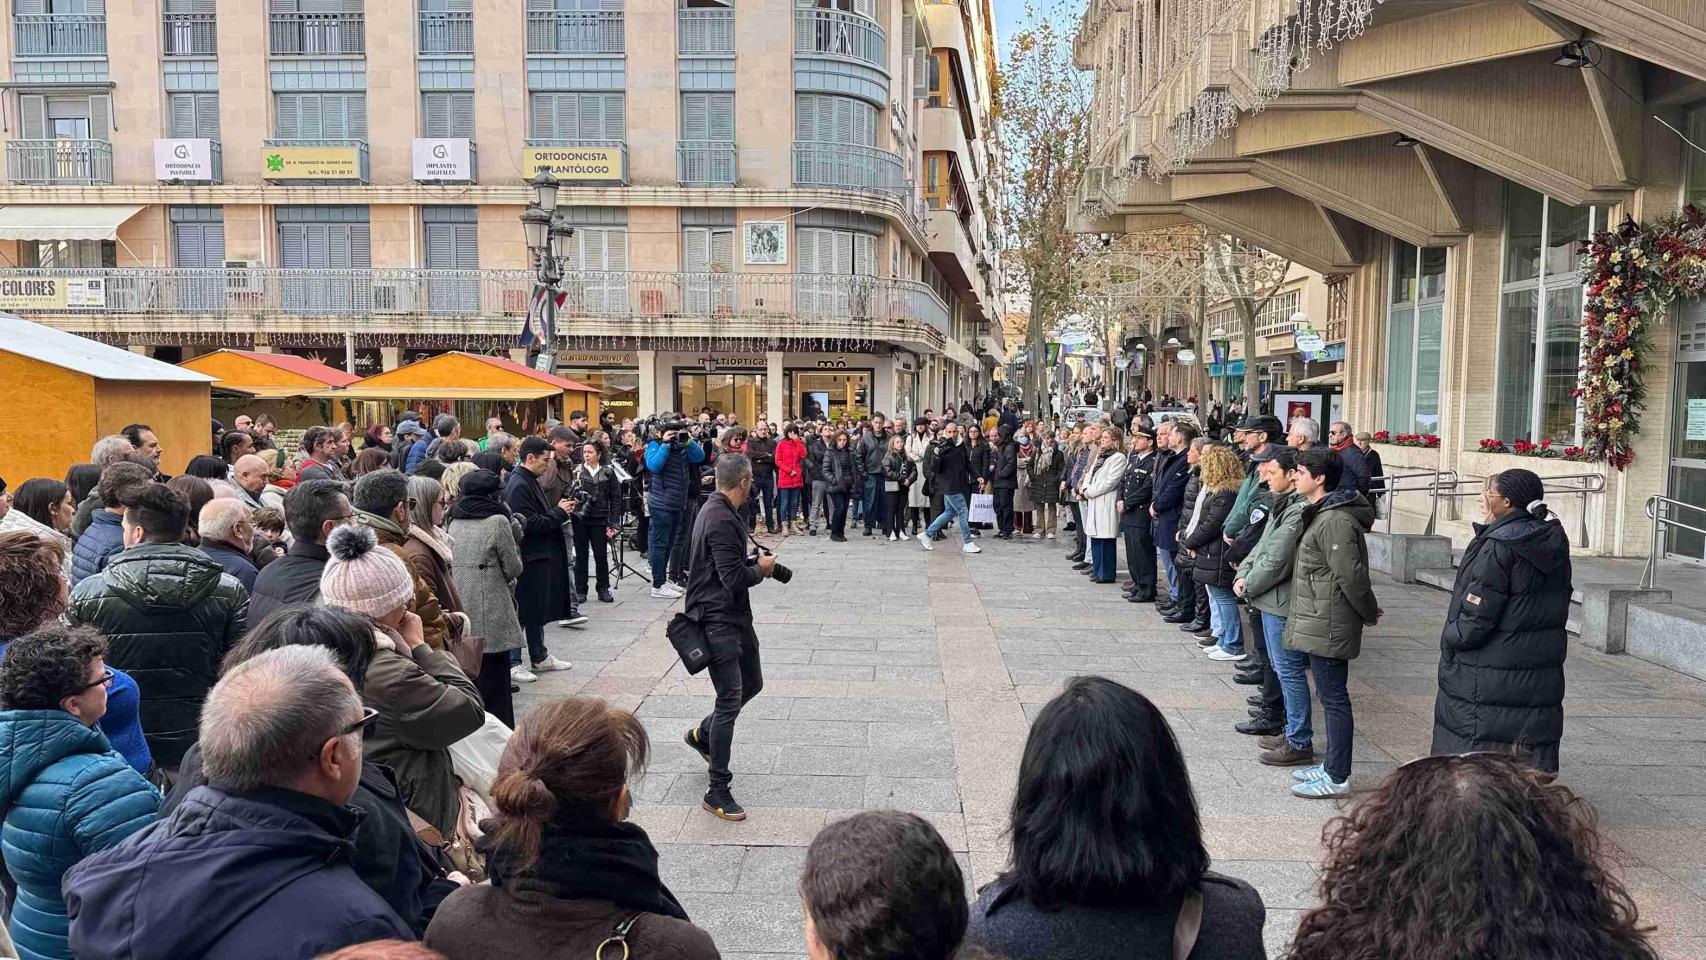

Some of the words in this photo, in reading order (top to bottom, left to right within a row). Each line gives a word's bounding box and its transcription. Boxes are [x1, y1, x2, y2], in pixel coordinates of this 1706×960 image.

[534, 152, 608, 161] ORTODONCISTA
[533, 163, 609, 174] ILANTÓLOGO
[2, 280, 56, 296] COLORES
[589, 354, 623, 362] AUDITIVO
